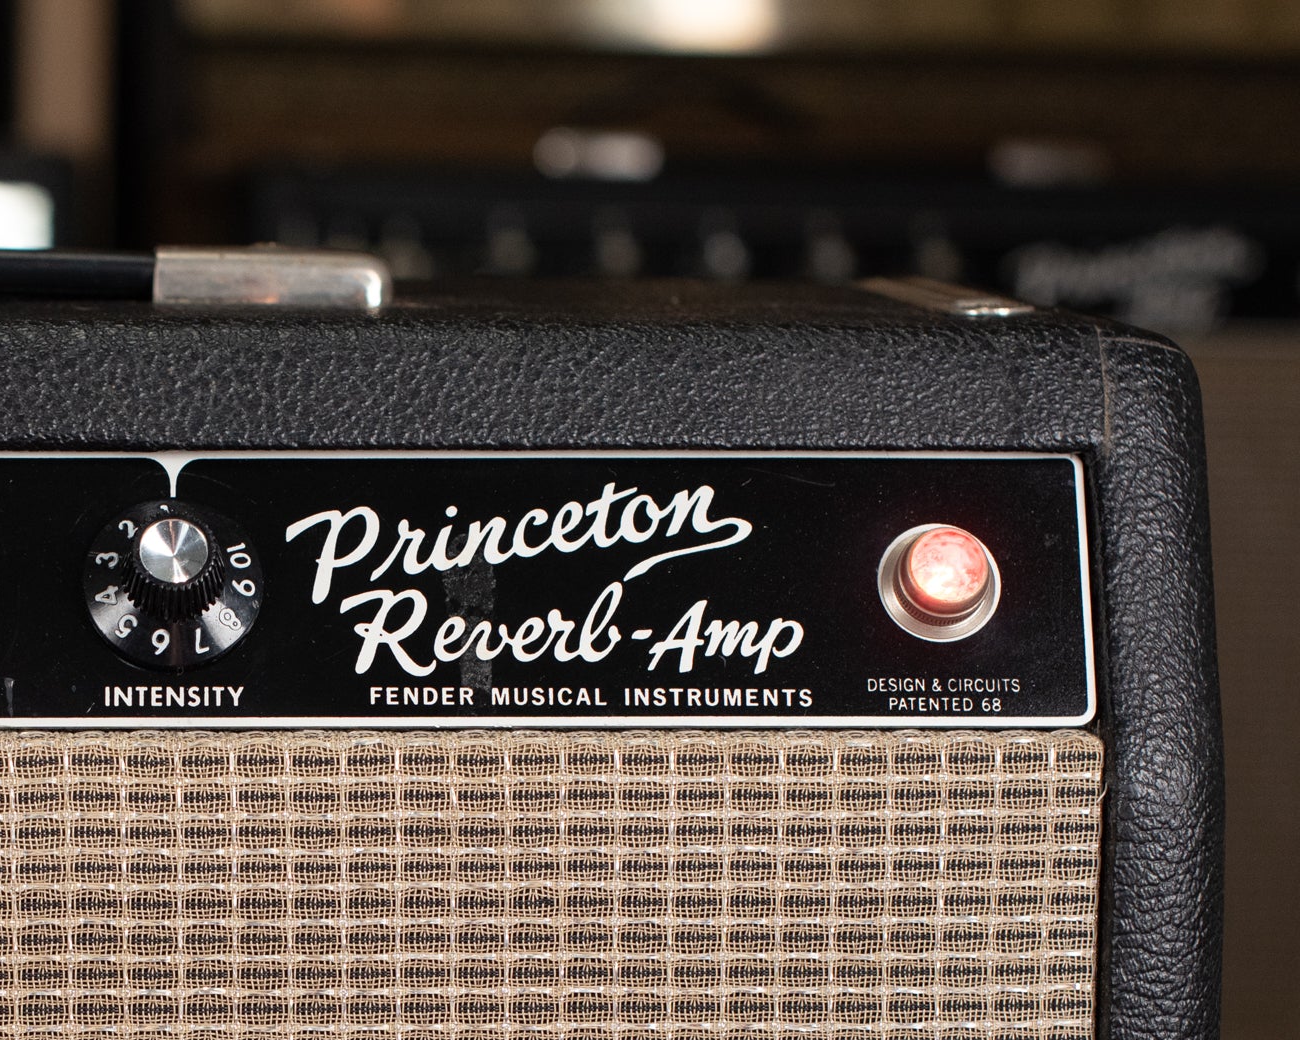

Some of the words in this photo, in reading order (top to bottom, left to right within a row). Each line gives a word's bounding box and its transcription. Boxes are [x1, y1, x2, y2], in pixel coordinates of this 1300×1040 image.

[118, 520, 138, 539] 2
[285, 482, 753, 604] Princeton
[95, 552, 119, 568] 3
[227, 542, 251, 569] 10
[94, 585, 118, 605] 4
[232, 579, 256, 597] 9
[115, 614, 138, 639] 5
[219, 608, 242, 631] 8
[340, 581, 804, 677] Reverb-Amp
[152, 628, 170, 656] 6
[195, 628, 210, 654] 7
[868, 678, 925, 692] DESIGN
[932, 679, 942, 691] &
[948, 679, 1020, 692] CIRCUITS
[105, 687, 243, 707] INTENSITY
[371, 687, 473, 705] FENDER
[492, 688, 607, 705] MUSICAL
[625, 688, 812, 707] INSTRUMENTS
[889, 697, 973, 711] PATENTED
[982, 698, 1001, 712] 68
